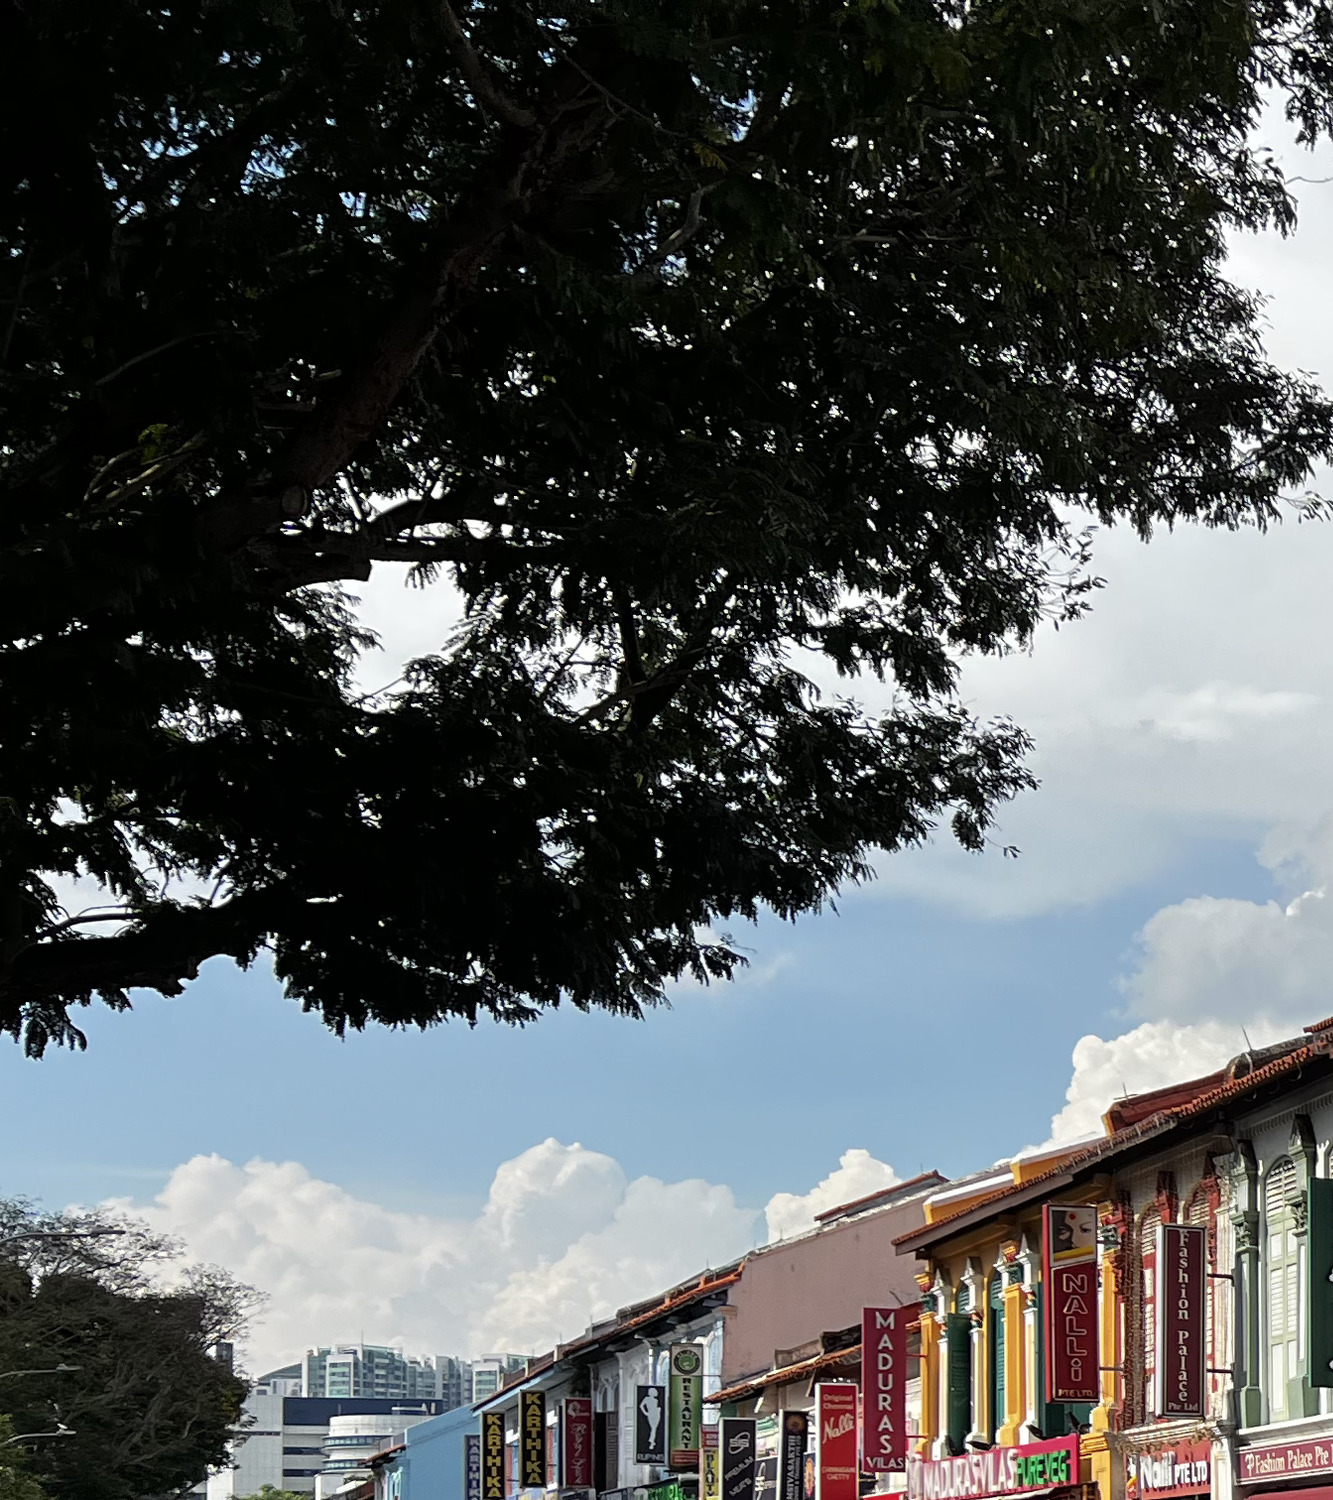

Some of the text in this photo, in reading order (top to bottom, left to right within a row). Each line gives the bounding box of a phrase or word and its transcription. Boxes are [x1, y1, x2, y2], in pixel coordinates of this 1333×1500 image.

[526, 1393, 542, 1484] KARTHIKA
[682, 1378, 692, 1449] RESTAURANT
[487, 1415, 502, 1497] KARTHIKA
[866, 1457, 904, 1469] VILAS
[1174, 1463, 1190, 1485] PTE
[1192, 1461, 1208, 1482] LTD
[1254, 1452, 1286, 1474] Fashion
[1287, 1448, 1313, 1469] Palace
[1315, 1445, 1329, 1465] Pte
